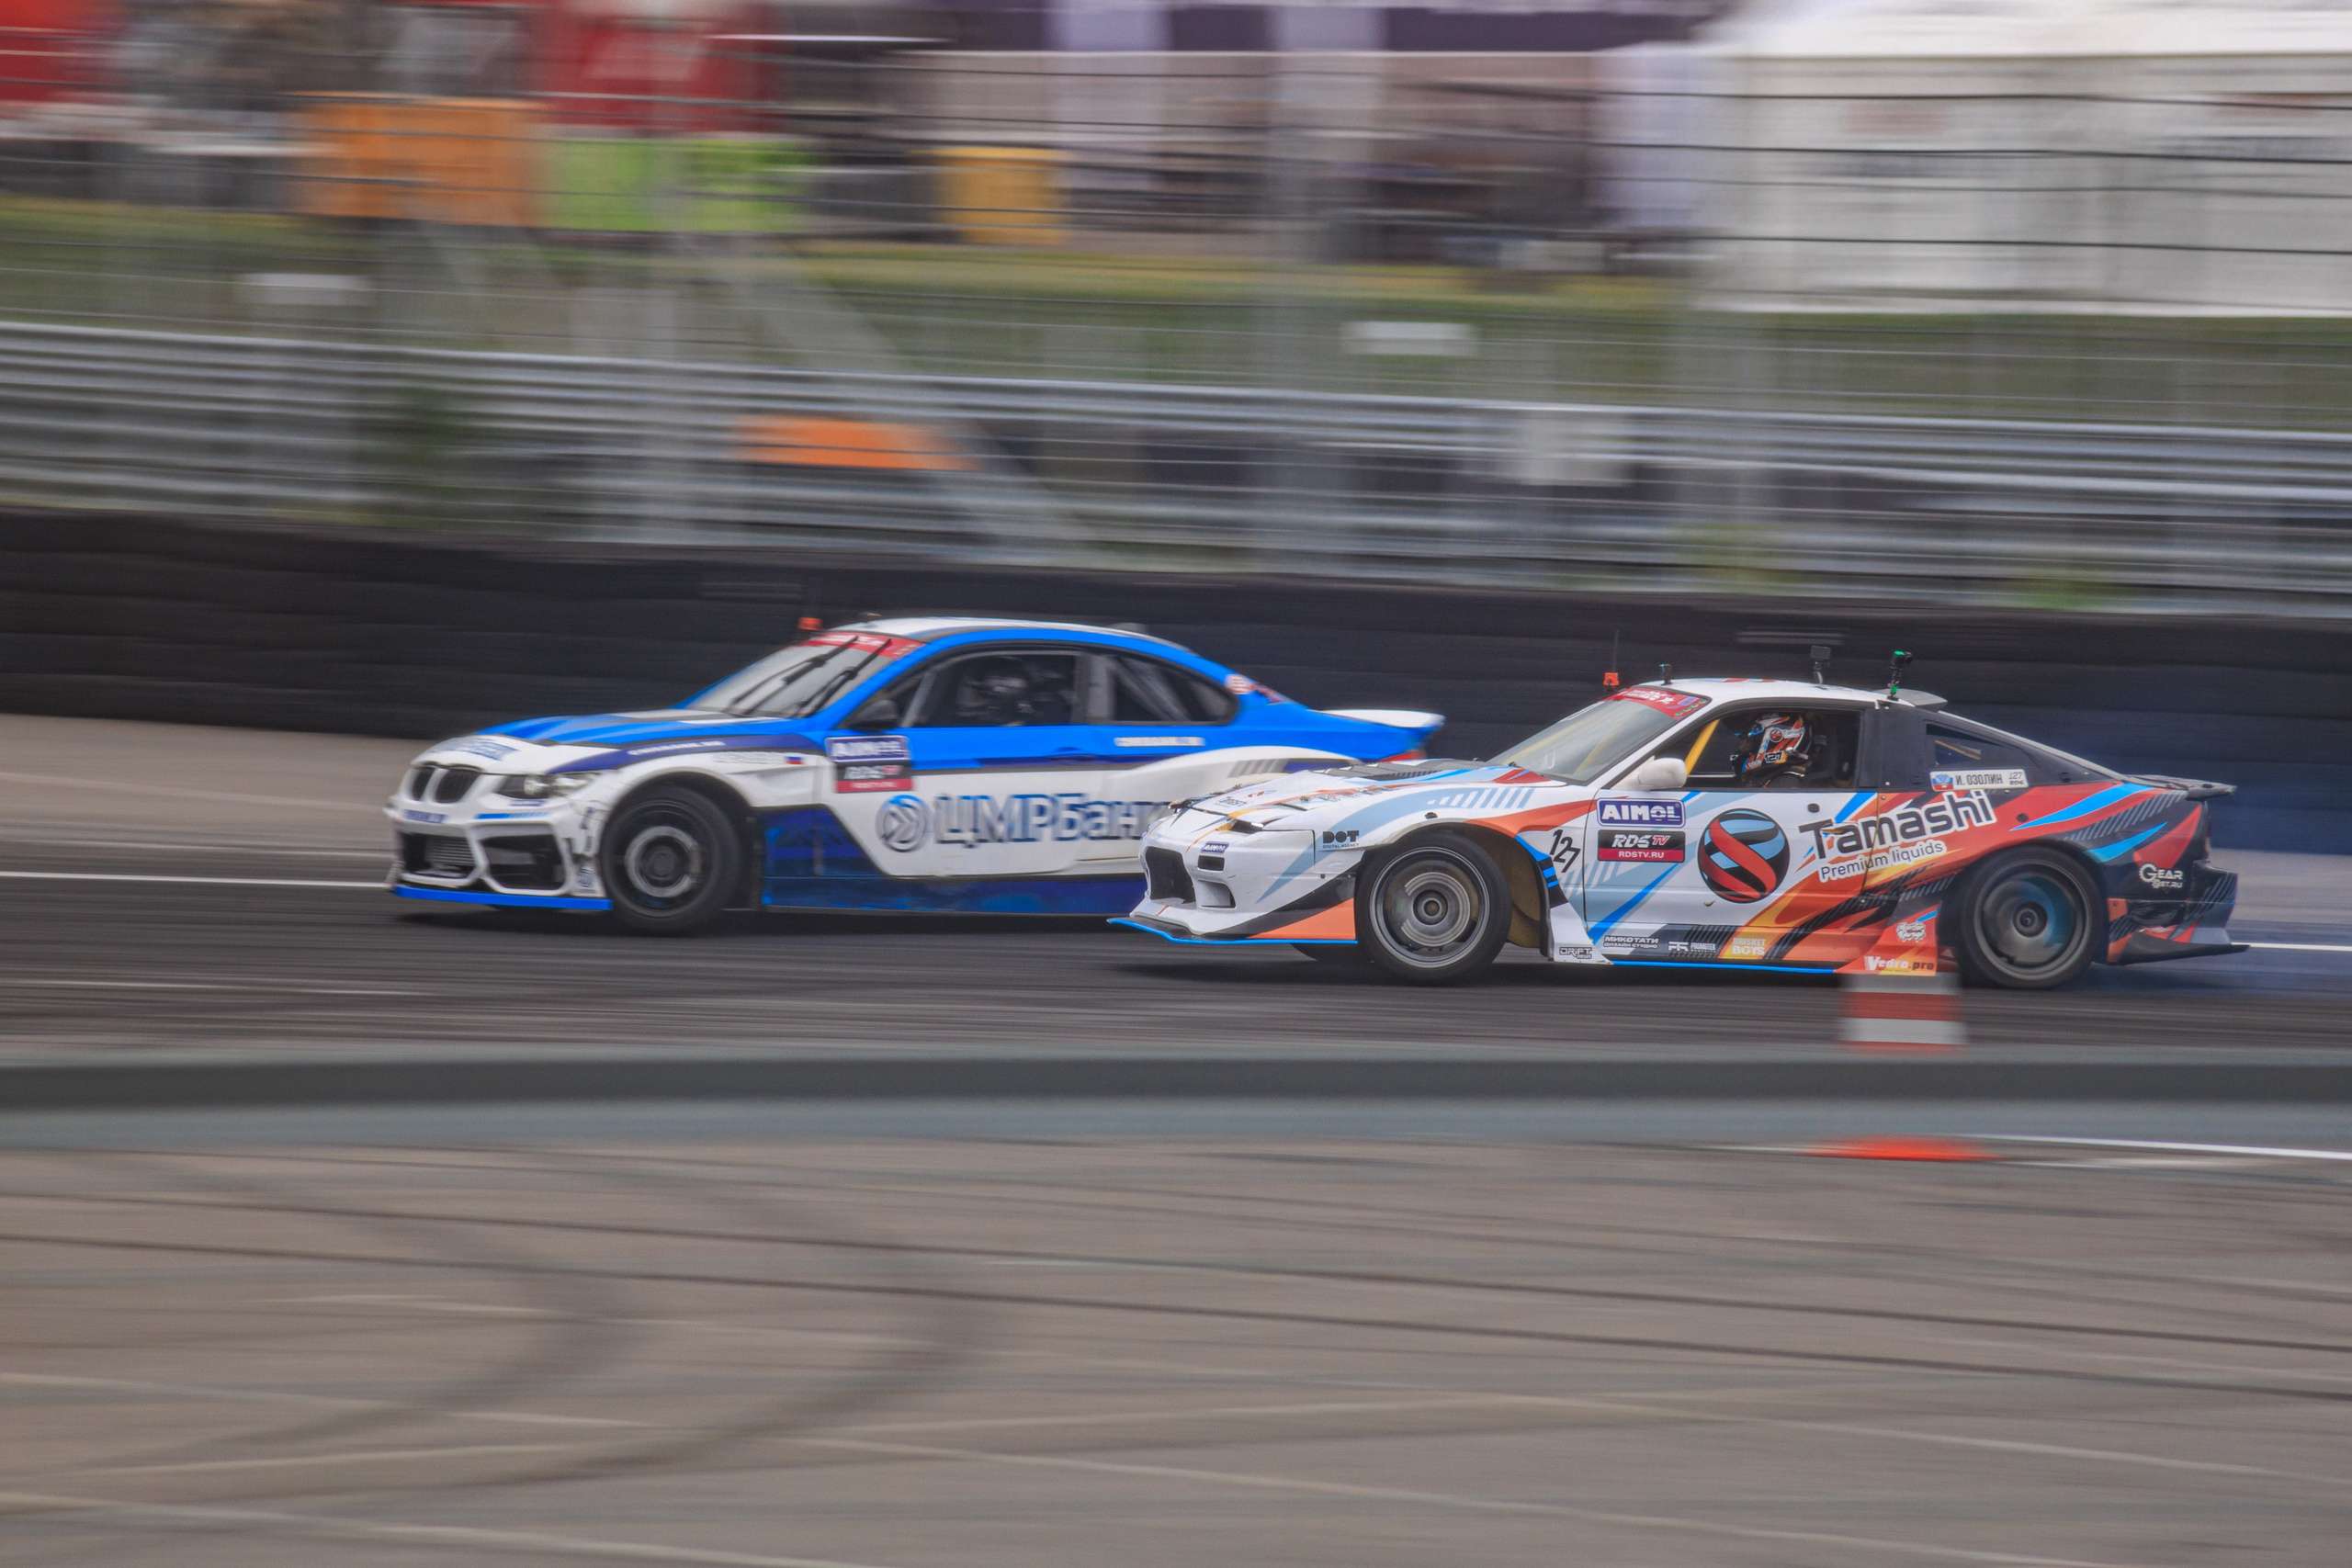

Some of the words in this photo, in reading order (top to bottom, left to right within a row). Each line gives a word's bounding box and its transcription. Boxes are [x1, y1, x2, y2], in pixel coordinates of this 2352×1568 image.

[1764, 752, 1781, 762] 127
[1966, 773, 2004, 785] ОЗОЛИН
[2008, 772, 2023, 780] 127
[1601, 805, 1680, 821] AIMOL
[1798, 790, 1996, 860] Tamashi
[1323, 830, 1359, 843] DOT
[1611, 834, 1653, 848] RDS
[1652, 834, 1671, 845] TV
[1549, 829, 1581, 873] 127
[1821, 854, 1888, 880] Premium
[1892, 841, 1944, 864] liquids
[1604, 936, 1659, 944] МИКОТАТИ
[1732, 937, 1766, 946] BRISKET
[1732, 945, 1765, 955] BOYS
[1864, 955, 1935, 971] Vedro.pro
